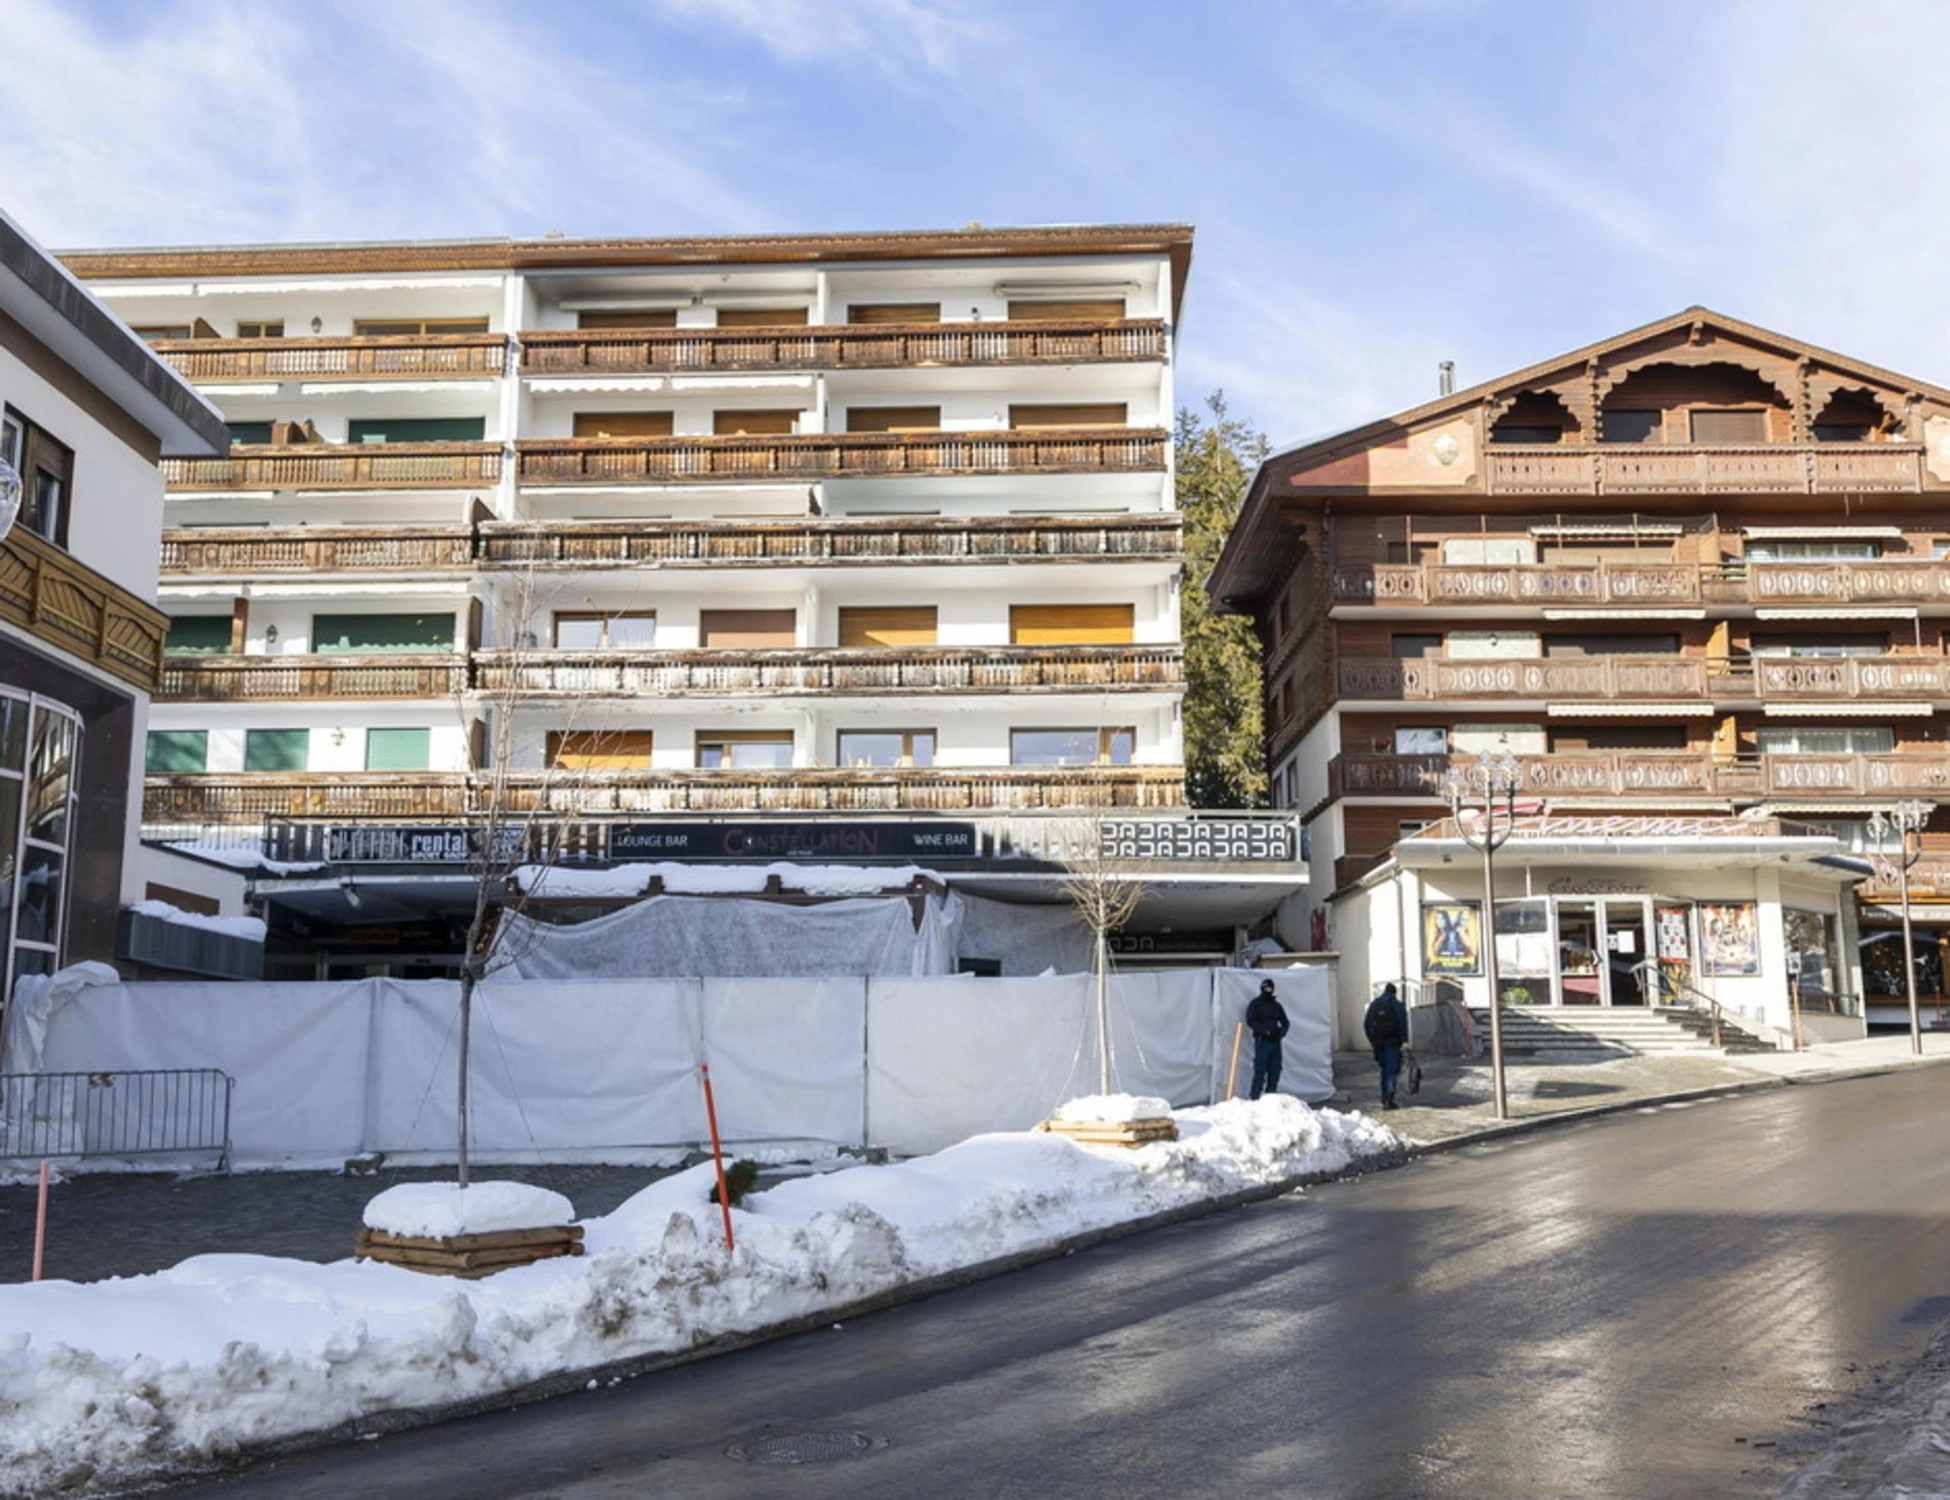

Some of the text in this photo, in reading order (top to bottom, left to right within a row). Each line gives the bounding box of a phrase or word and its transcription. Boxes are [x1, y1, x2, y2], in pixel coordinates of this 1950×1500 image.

[412, 831, 468, 852] rental
[617, 834, 688, 848] LOUNGE BAR
[723, 829, 879, 856] CONSTELLATION
[913, 833, 968, 846] WINE BAR
